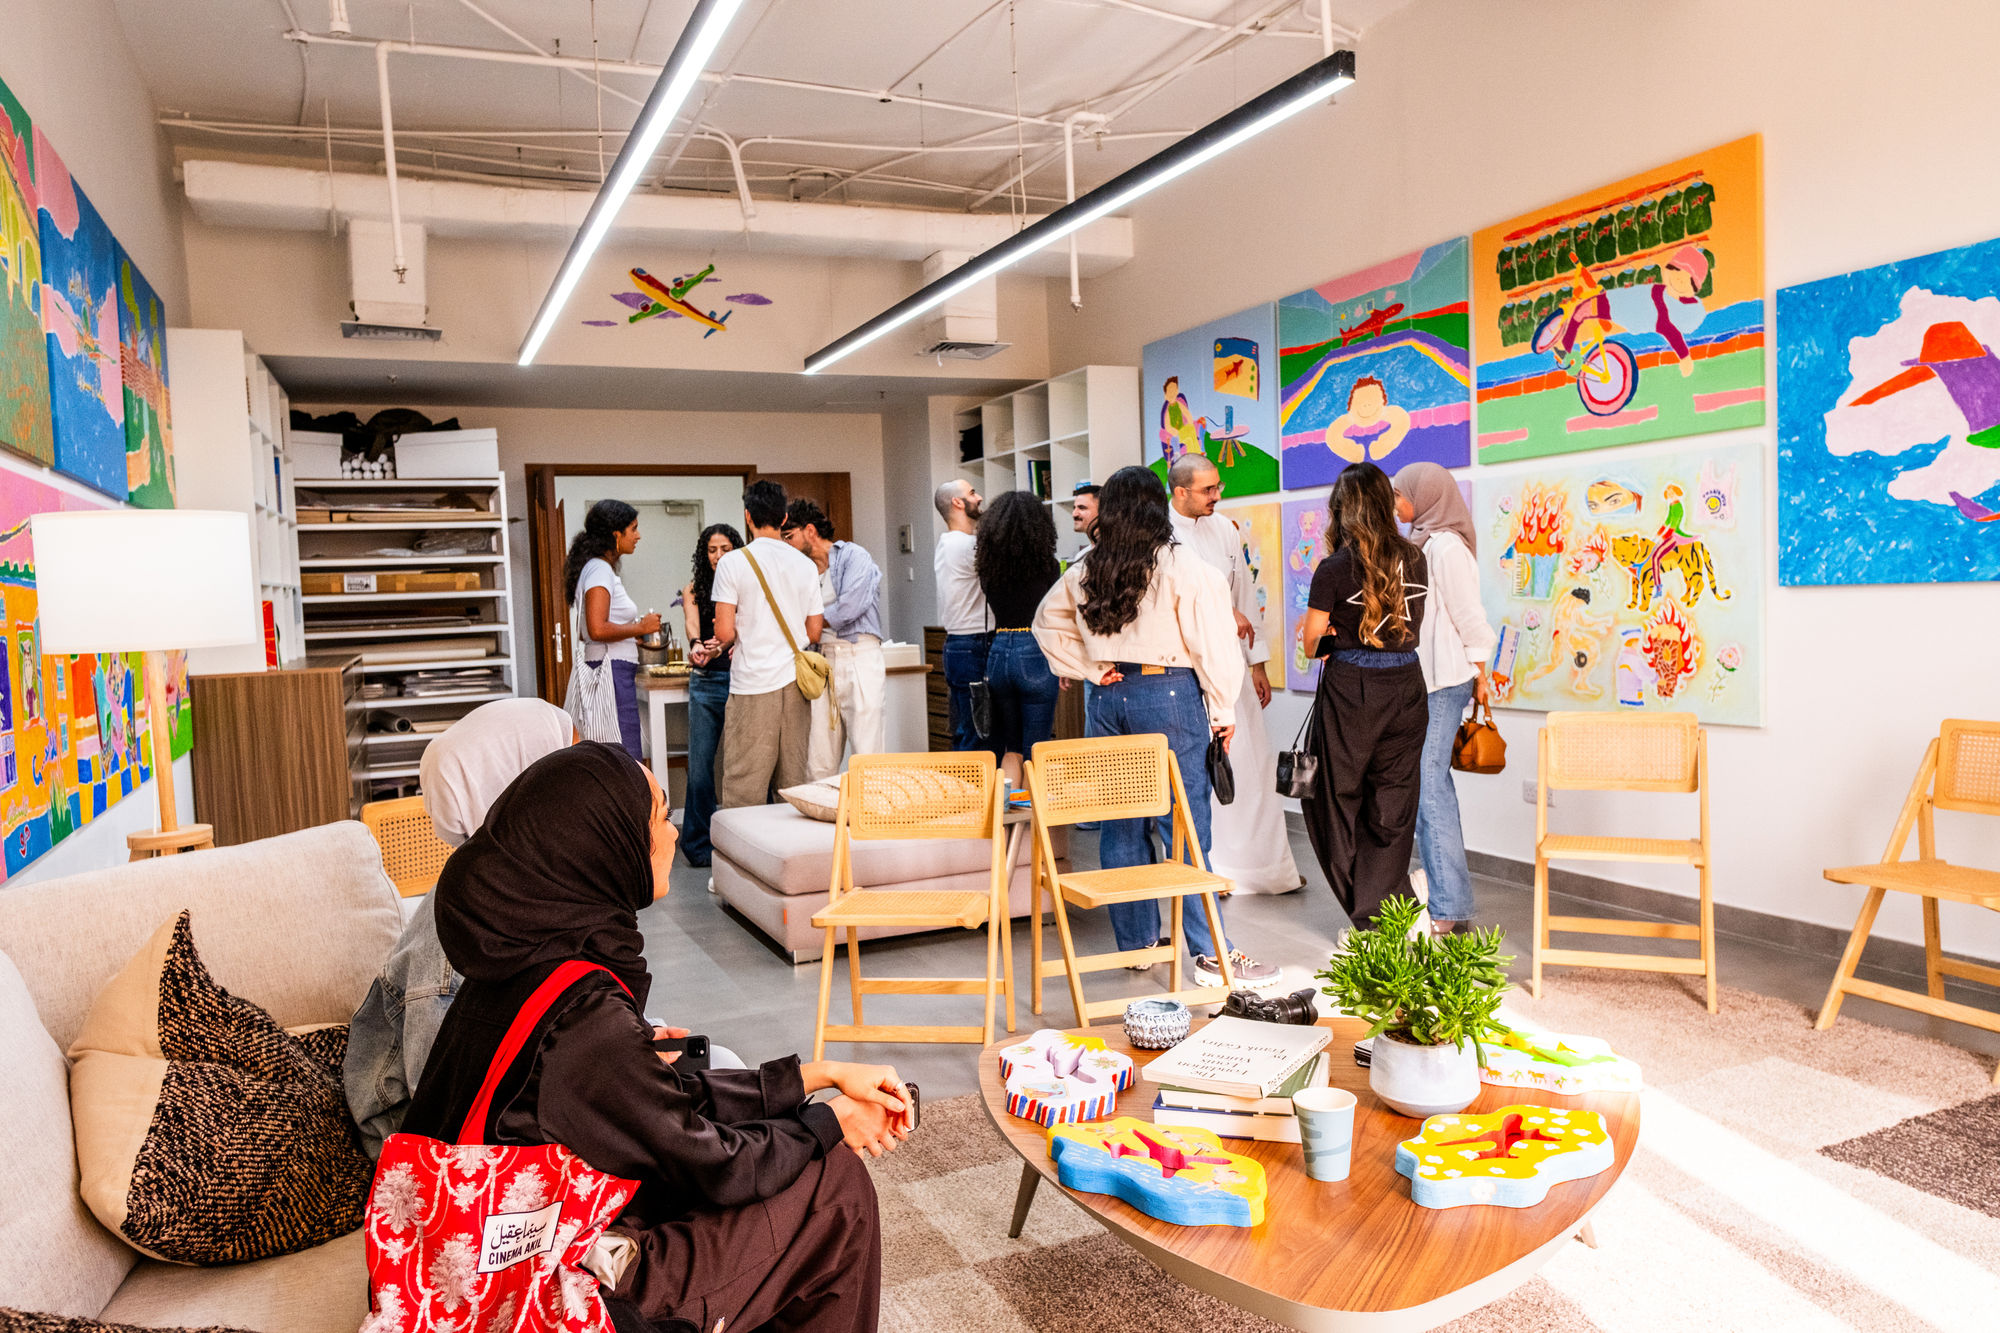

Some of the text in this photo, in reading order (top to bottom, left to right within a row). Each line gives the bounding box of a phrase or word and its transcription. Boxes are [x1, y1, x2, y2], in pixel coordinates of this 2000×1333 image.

[490, 1220, 547, 1250] سينما عقيل
[488, 1238, 542, 1265] CINEMA AKIL
